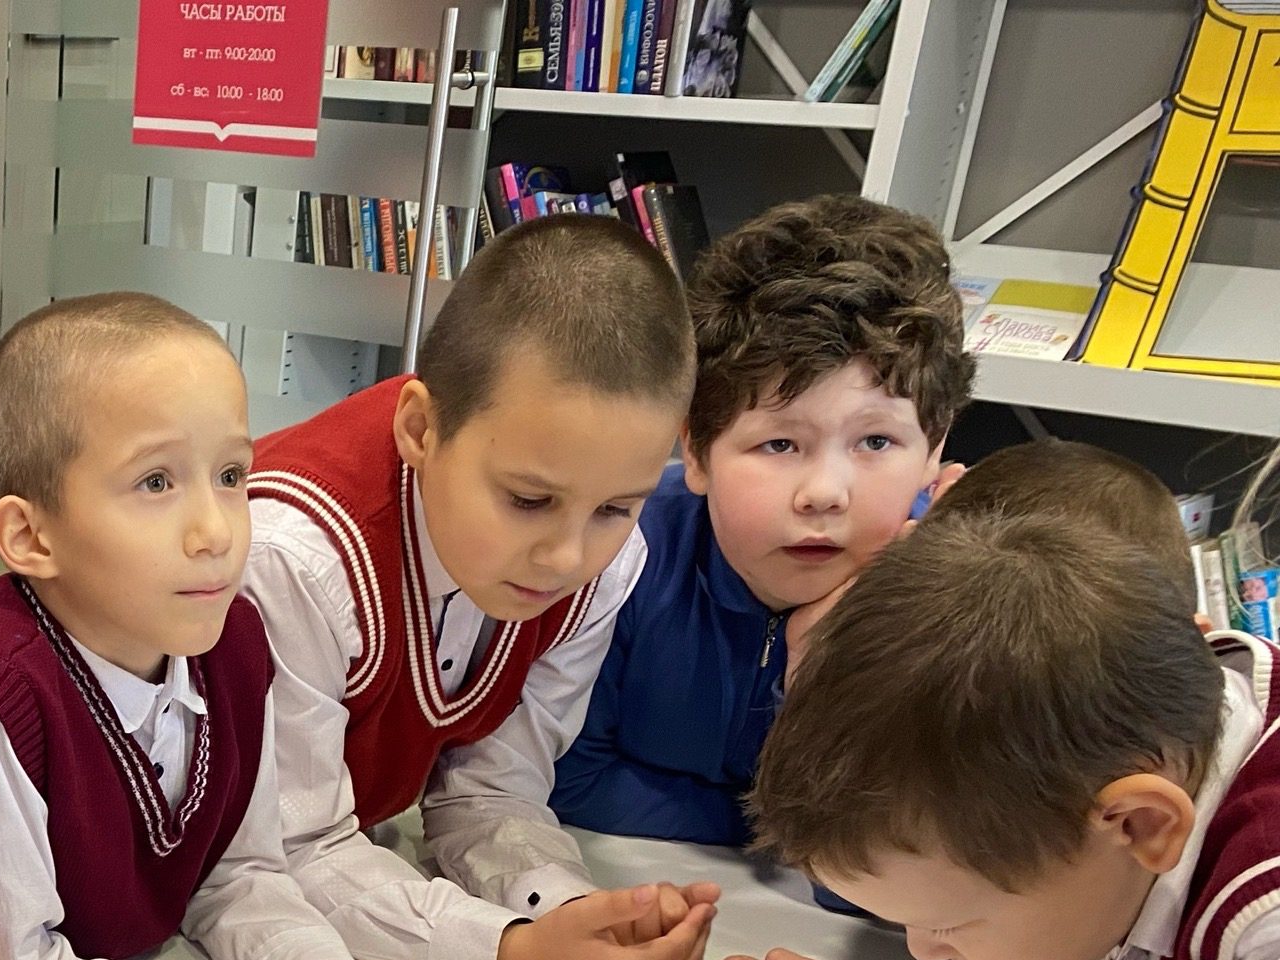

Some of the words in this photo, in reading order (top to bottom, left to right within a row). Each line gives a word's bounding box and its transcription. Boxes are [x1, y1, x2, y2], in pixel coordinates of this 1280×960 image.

[180, 4, 222, 21] ЧАСЫ
[225, 5, 286, 22] РАБОТЫ
[183, 48, 198, 59] вт
[205, 48, 222, 60] пт:
[650, 38, 669, 92] ПЛАТОН
[170, 83, 185, 96] сб
[193, 86, 210, 97] вс:
